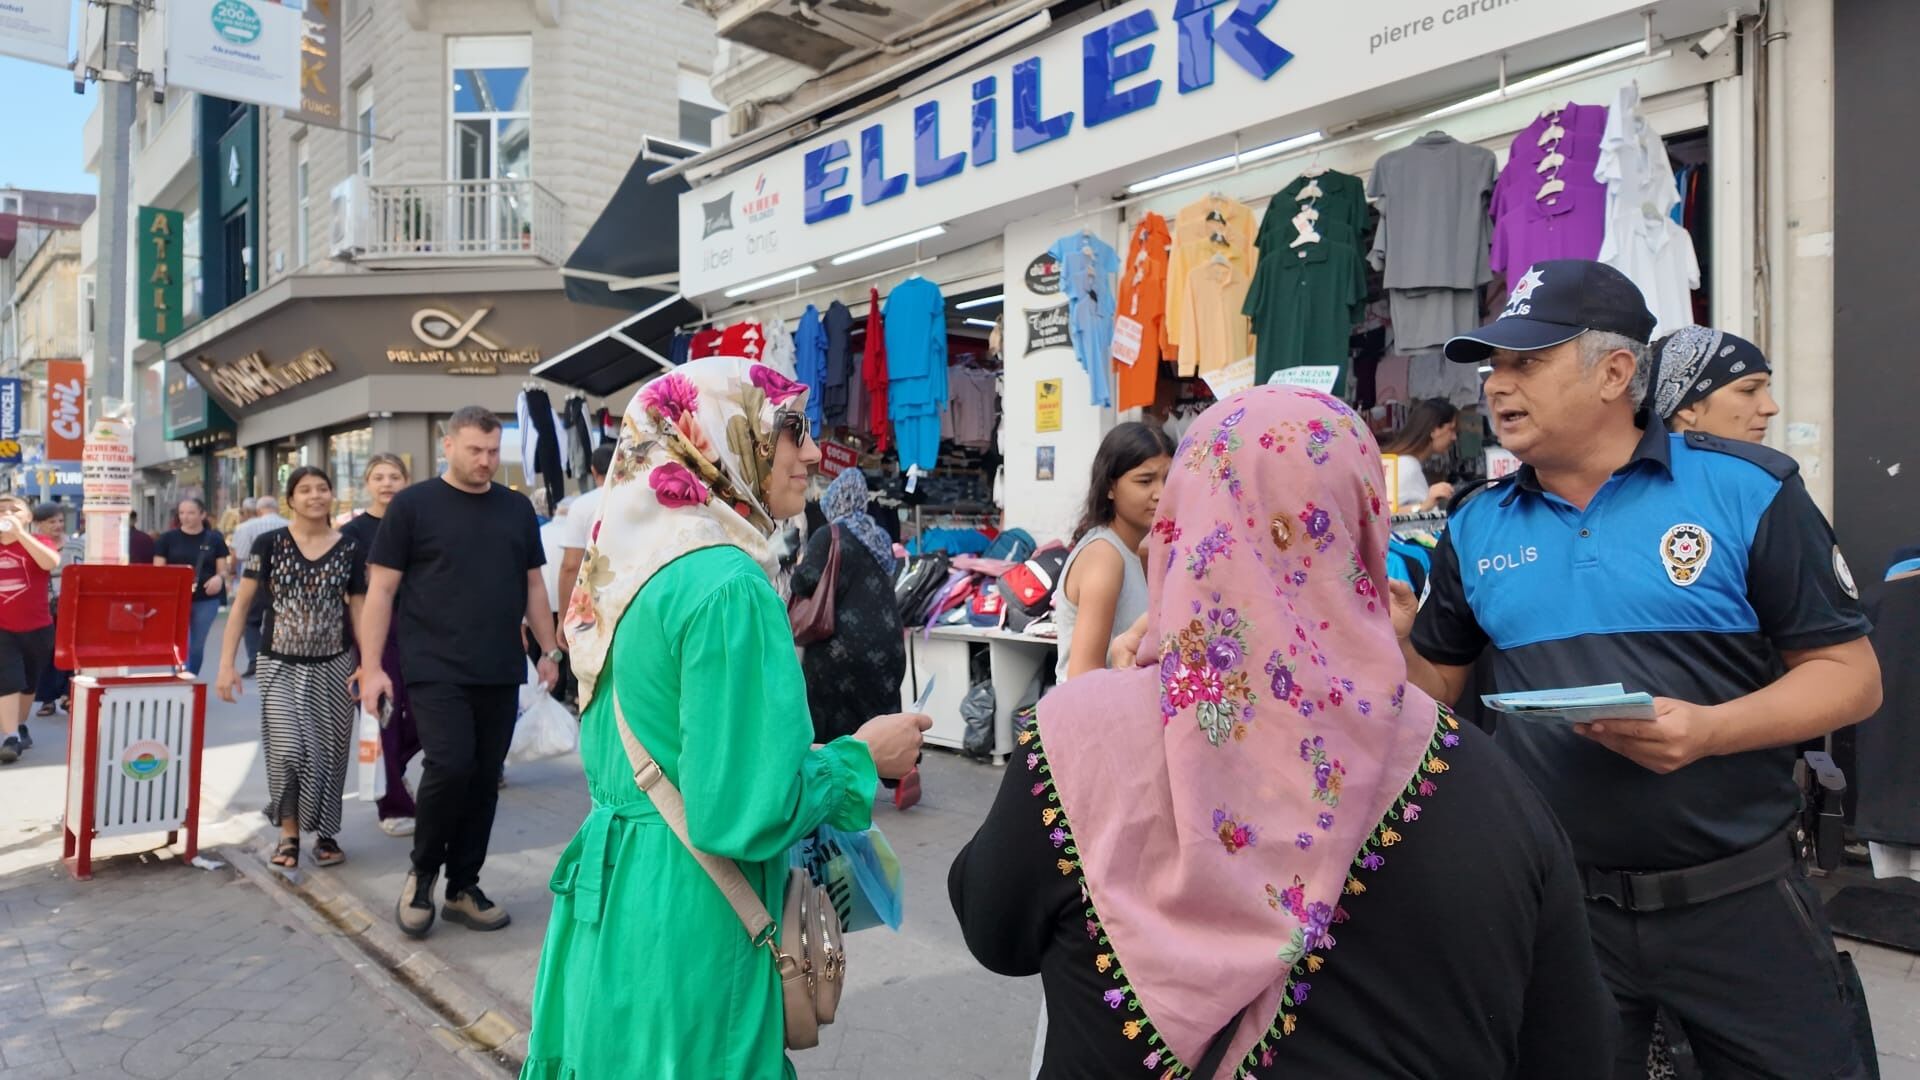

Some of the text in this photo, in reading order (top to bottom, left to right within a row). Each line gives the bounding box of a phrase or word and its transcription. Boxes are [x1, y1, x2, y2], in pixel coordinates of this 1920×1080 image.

[1370, 0, 1520, 54] pierre card
[386, 350, 455, 363] PIRLANTA
[470, 350, 541, 363] KUYUMCU
[1477, 544, 1538, 576] POLİS
